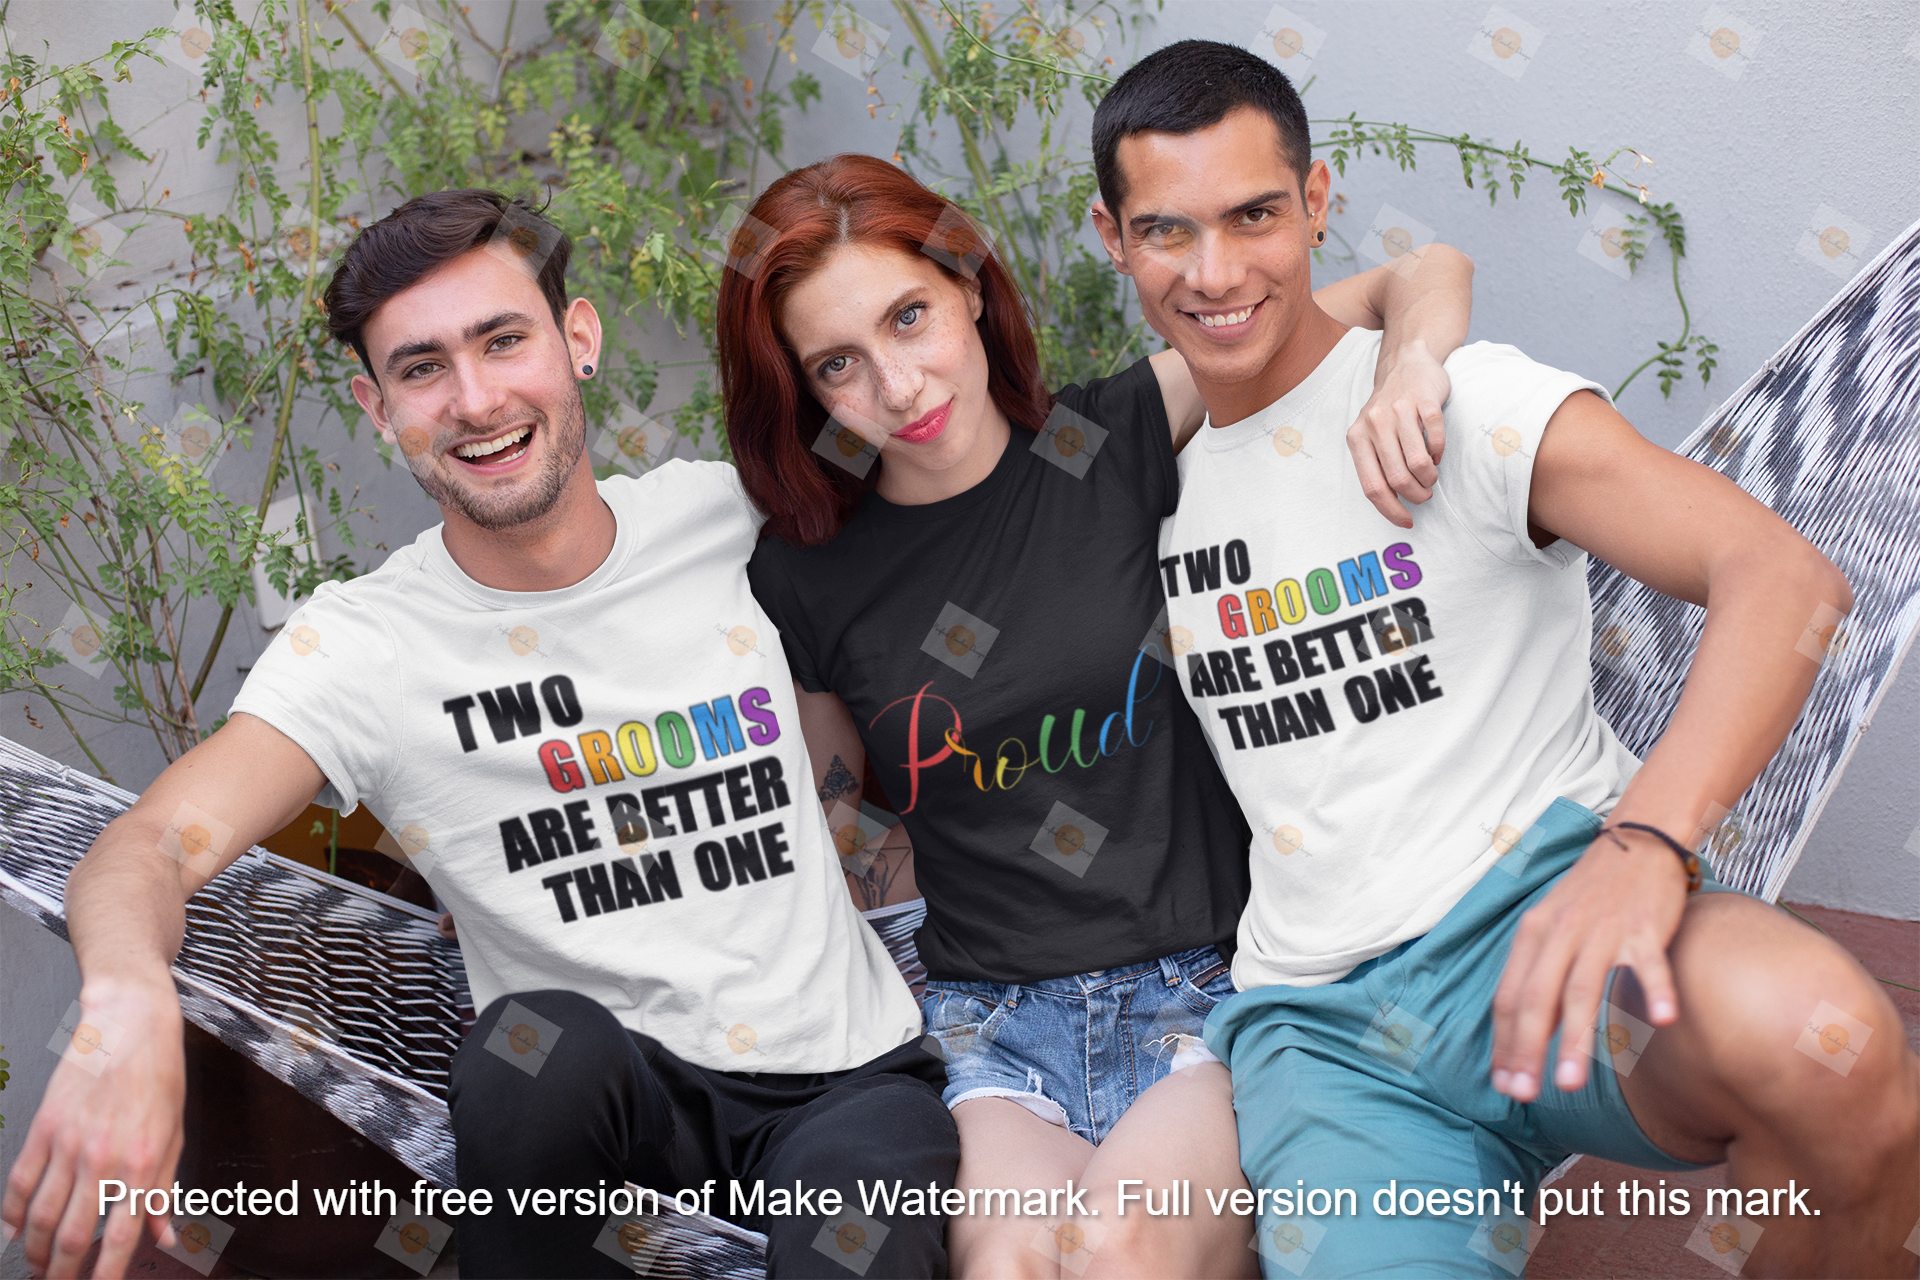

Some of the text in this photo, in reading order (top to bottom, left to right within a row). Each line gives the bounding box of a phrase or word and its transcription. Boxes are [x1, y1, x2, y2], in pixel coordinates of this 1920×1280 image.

[1160, 538, 1251, 598] TWO
[1217, 542, 1423, 639] GROOMS
[1186, 646, 1263, 698] ARE
[1263, 597, 1435, 686] BETTER
[442, 674, 583, 753] TWO
[537, 686, 781, 793] GROOMS
[869, 642, 1162, 815] Proud
[1217, 654, 1443, 750] THAN ONE
[499, 800, 602, 874] ARE
[605, 755, 791, 846] BETTER
[541, 850, 683, 923] THAN
[694, 822, 795, 892] ONE
